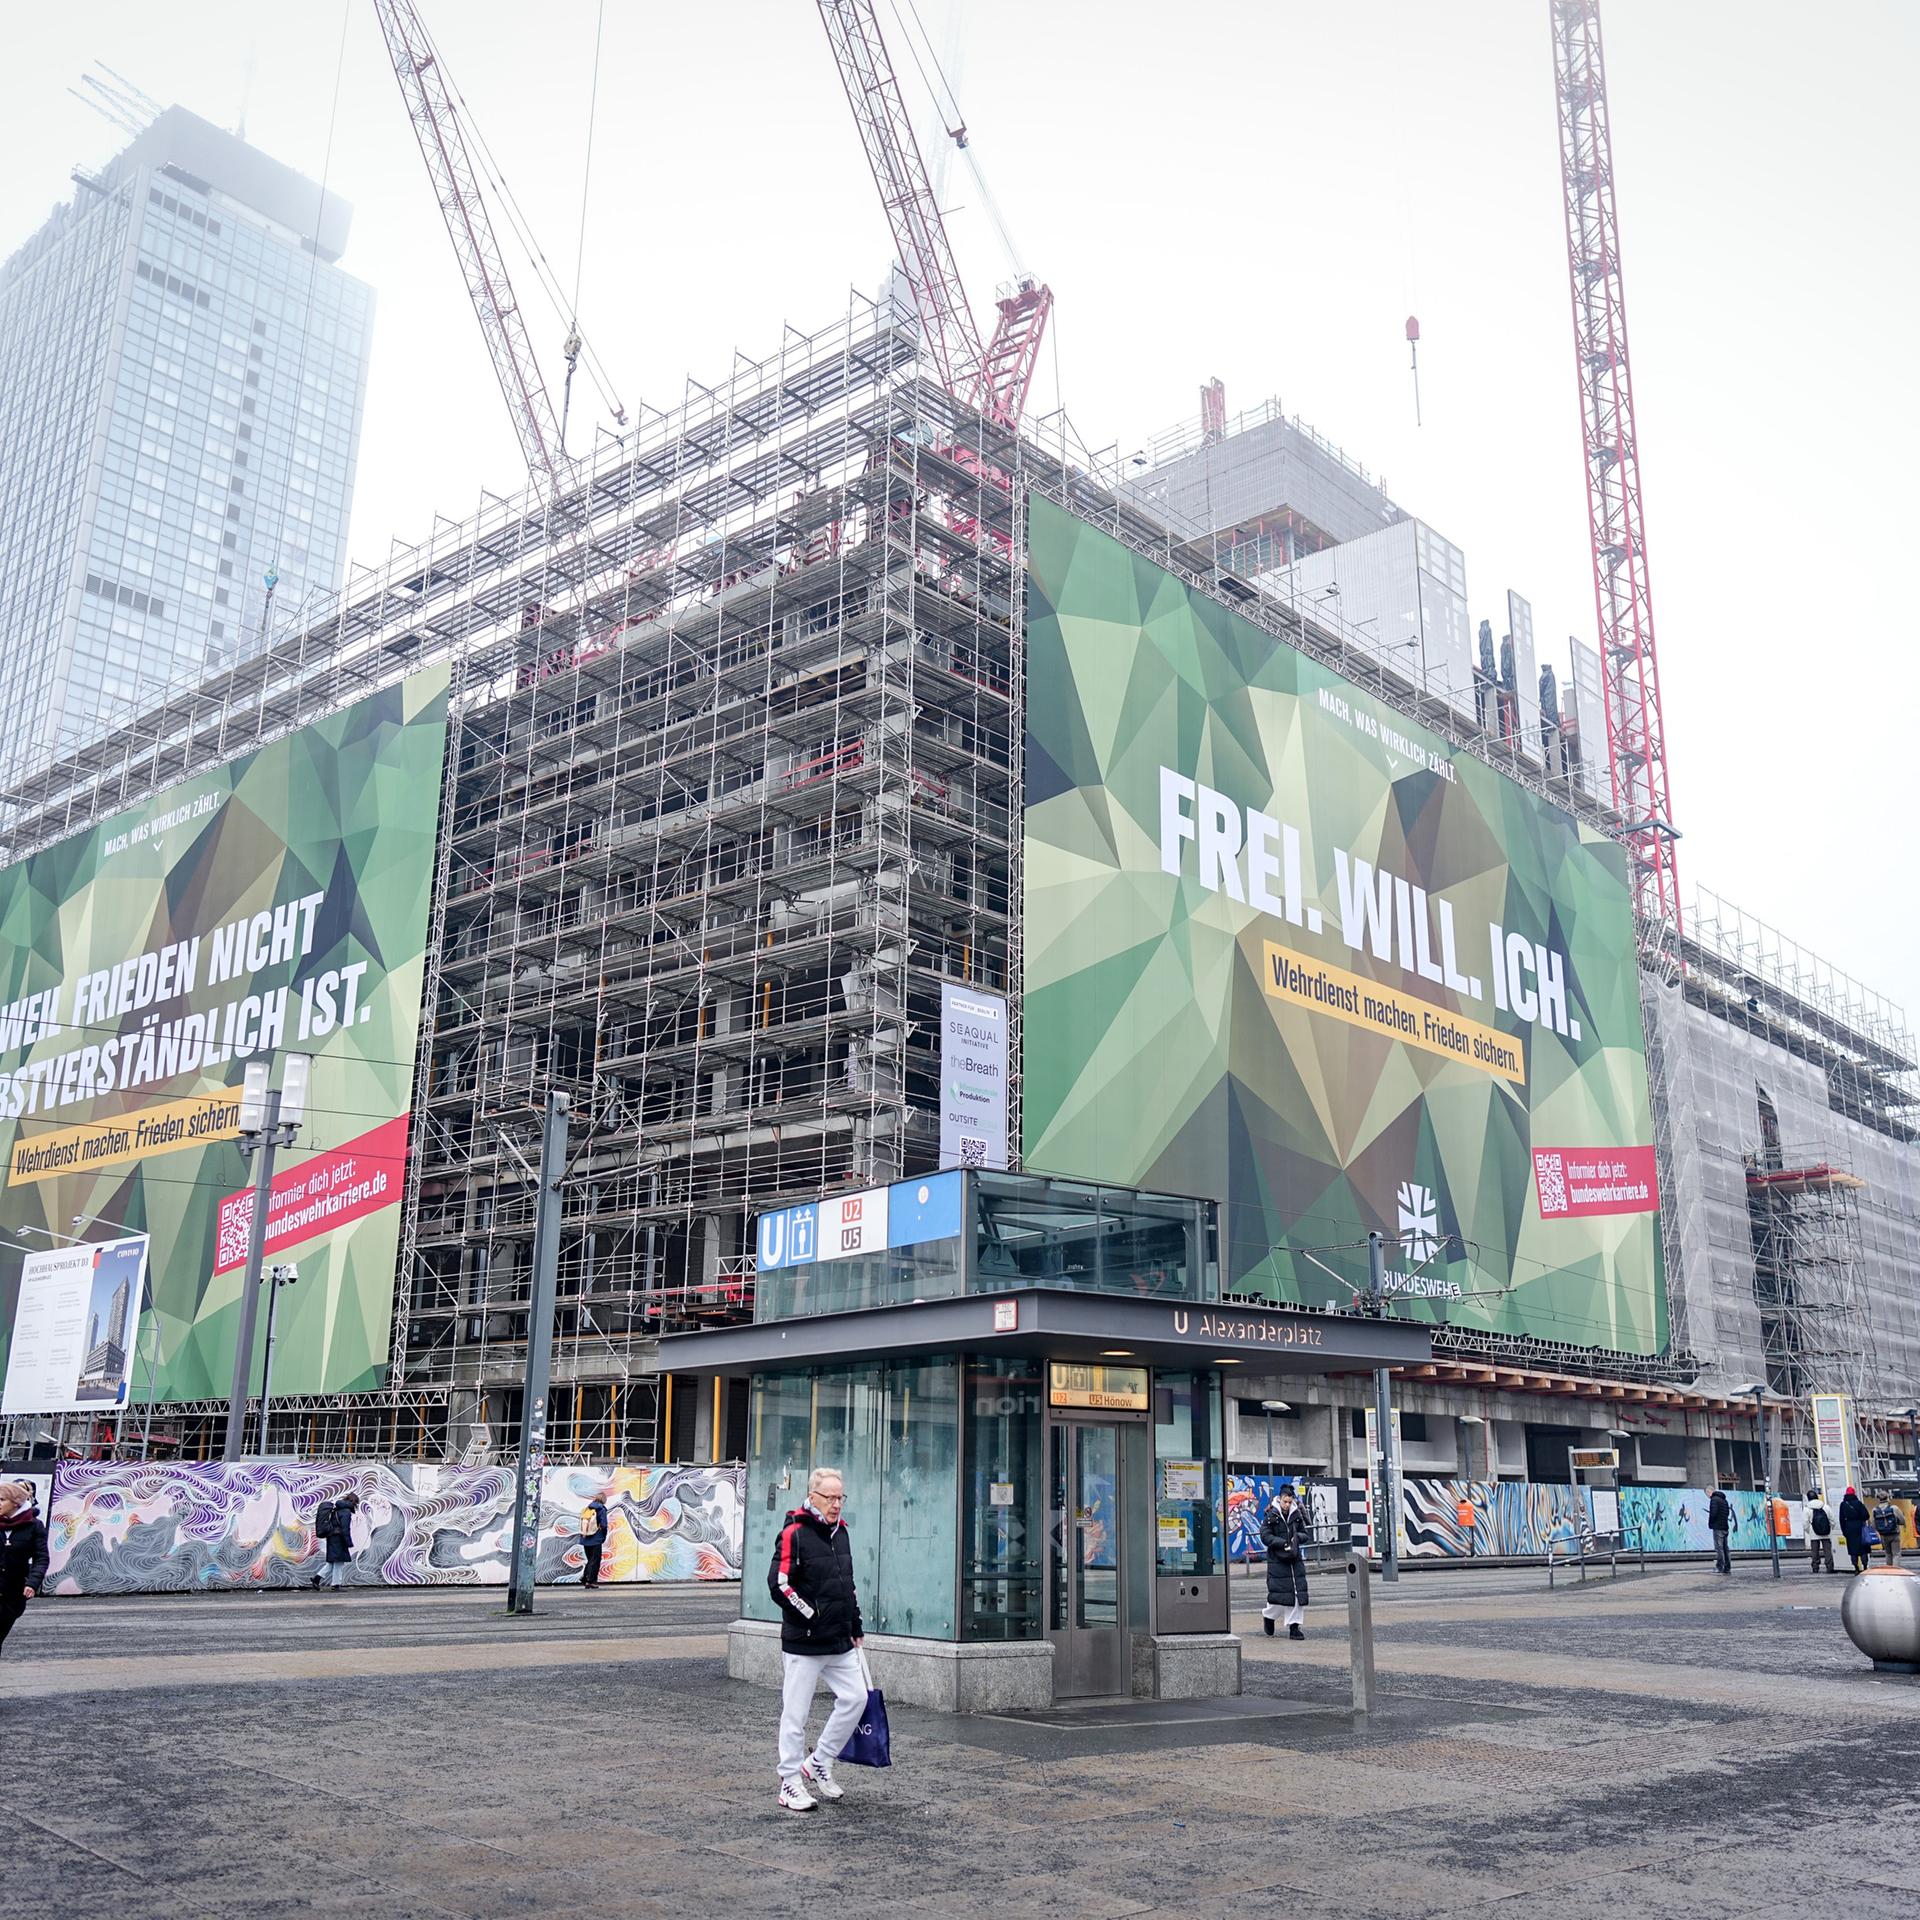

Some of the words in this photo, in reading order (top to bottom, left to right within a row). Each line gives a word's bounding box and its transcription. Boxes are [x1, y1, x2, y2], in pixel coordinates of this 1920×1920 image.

[1319, 688, 1352, 727] MACH,
[1355, 709, 1377, 738] WAS
[1380, 723, 1426, 766] WIRKLICH
[1429, 752, 1457, 784] ZÄHLT.
[104, 832, 128, 857] MACH,
[131, 822, 149, 845] WAS
[151, 803, 191, 836] WIRKLICH
[192, 792, 220, 818] ZÄHLT.
[1159, 765, 1323, 935] FREI.
[1333, 847, 1483, 1001] WILL.
[1490, 922, 1582, 1042] ICH.
[0, 986, 62, 1054] WEIL
[71, 935, 201, 1030] FRIEDEN
[207, 890, 324, 986] NICHT
[297, 960, 372, 1041] IST.
[1271, 954, 1359, 1015] Wehrdienst
[1364, 996, 1421, 1041] machen,
[1424, 1012, 1470, 1055] Frieden
[1473, 1034, 1519, 1073] sichern.
[950, 1021, 999, 1044] SEAQUAL
[961, 1038, 989, 1050] INITIATIVE
[959, 1090, 991, 1104] Produktion
[949, 1112, 978, 1127] OUTSITE
[16, 1135, 80, 1176] Wehrdienst
[82, 1127, 130, 1156] machen,
[135, 1113, 185, 1149] Frieden
[187, 1103, 241, 1137] sichern.
[308, 1168, 329, 1194] dich
[331, 1159, 356, 1190] jetzt:
[1567, 1161, 1597, 1180] Informier
[1597, 1161, 1612, 1179] dich
[1611, 1161, 1628, 1182] jetzt:
[1570, 1181, 1648, 1203] bundeswehrkarriere.de
[844, 1201, 861, 1220] U2
[762, 1214, 783, 1266] U
[843, 1229, 860, 1249] U5
[1174, 1311, 1189, 1334] U
[1200, 1314, 1322, 1348] Alexanderplatz
[1052, 1365, 1067, 1389] U
[1054, 1392, 1066, 1403] U2
[1090, 1394, 1102, 1405] U5
